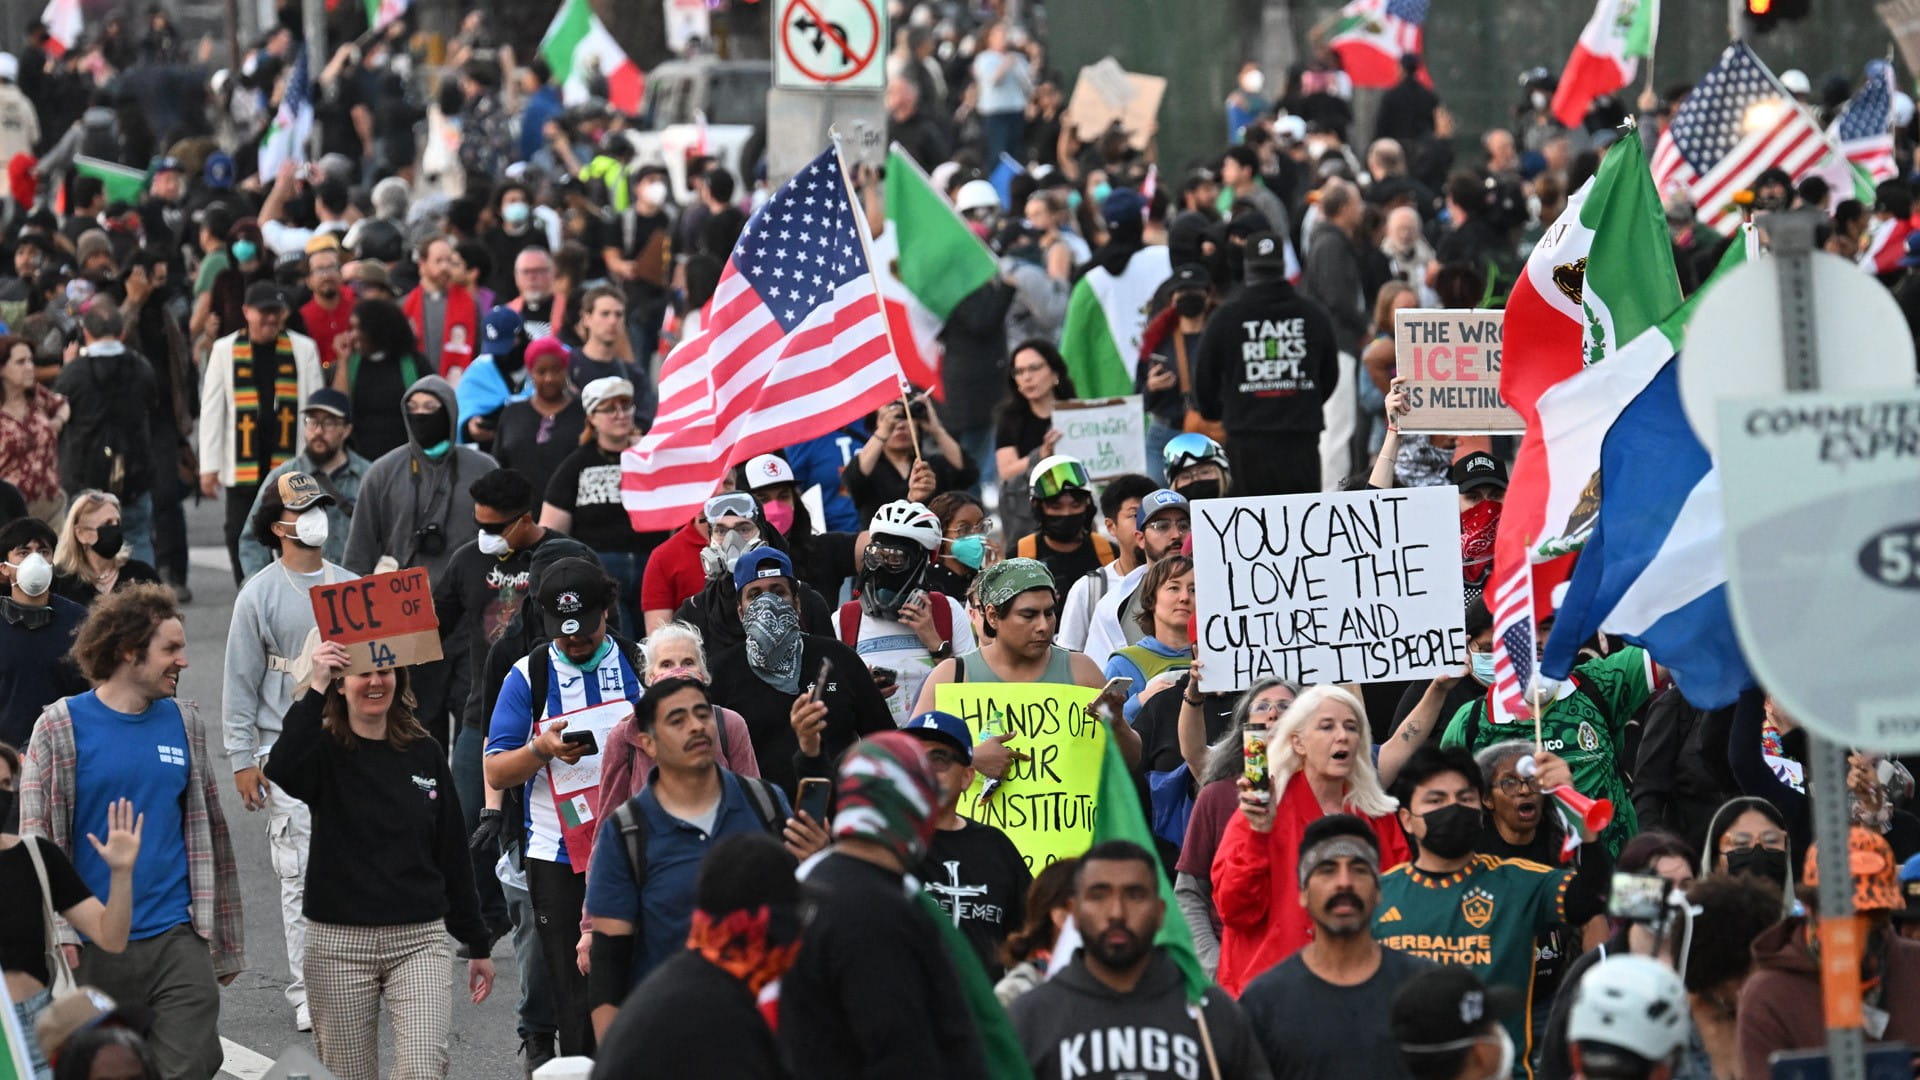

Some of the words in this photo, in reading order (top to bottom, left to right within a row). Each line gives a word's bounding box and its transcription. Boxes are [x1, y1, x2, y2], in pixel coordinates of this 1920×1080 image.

[1242, 318, 1305, 339] TAKE
[1404, 321, 1450, 344] THE
[1246, 359, 1306, 381] DEPT.
[1413, 345, 1479, 382] ICE
[1486, 350, 1502, 372] IS
[1745, 402, 1920, 437] COMMUTE
[1098, 440, 1114, 456] LA
[1201, 505, 1289, 565] YOU
[1300, 494, 1408, 557] CAN'T
[1879, 532, 1920, 582] 5
[1227, 554, 1328, 611] LOVE
[1341, 544, 1429, 599] THE
[321, 582, 382, 636] ICE
[390, 573, 422, 594] OUT
[402, 598, 421, 616] OF
[1205, 607, 1330, 652] CULTURE
[1339, 603, 1399, 642] AND
[368, 641, 396, 668] LA
[1234, 644, 1318, 689] HATE
[1391, 627, 1467, 675] PEOPLE
[599, 667, 623, 691] H
[922, 713, 939, 729] LA
[960, 697, 1061, 740] HANDS
[961, 791, 1097, 832] ONSTITUTI
[1059, 1025, 1200, 1080] KINGS
